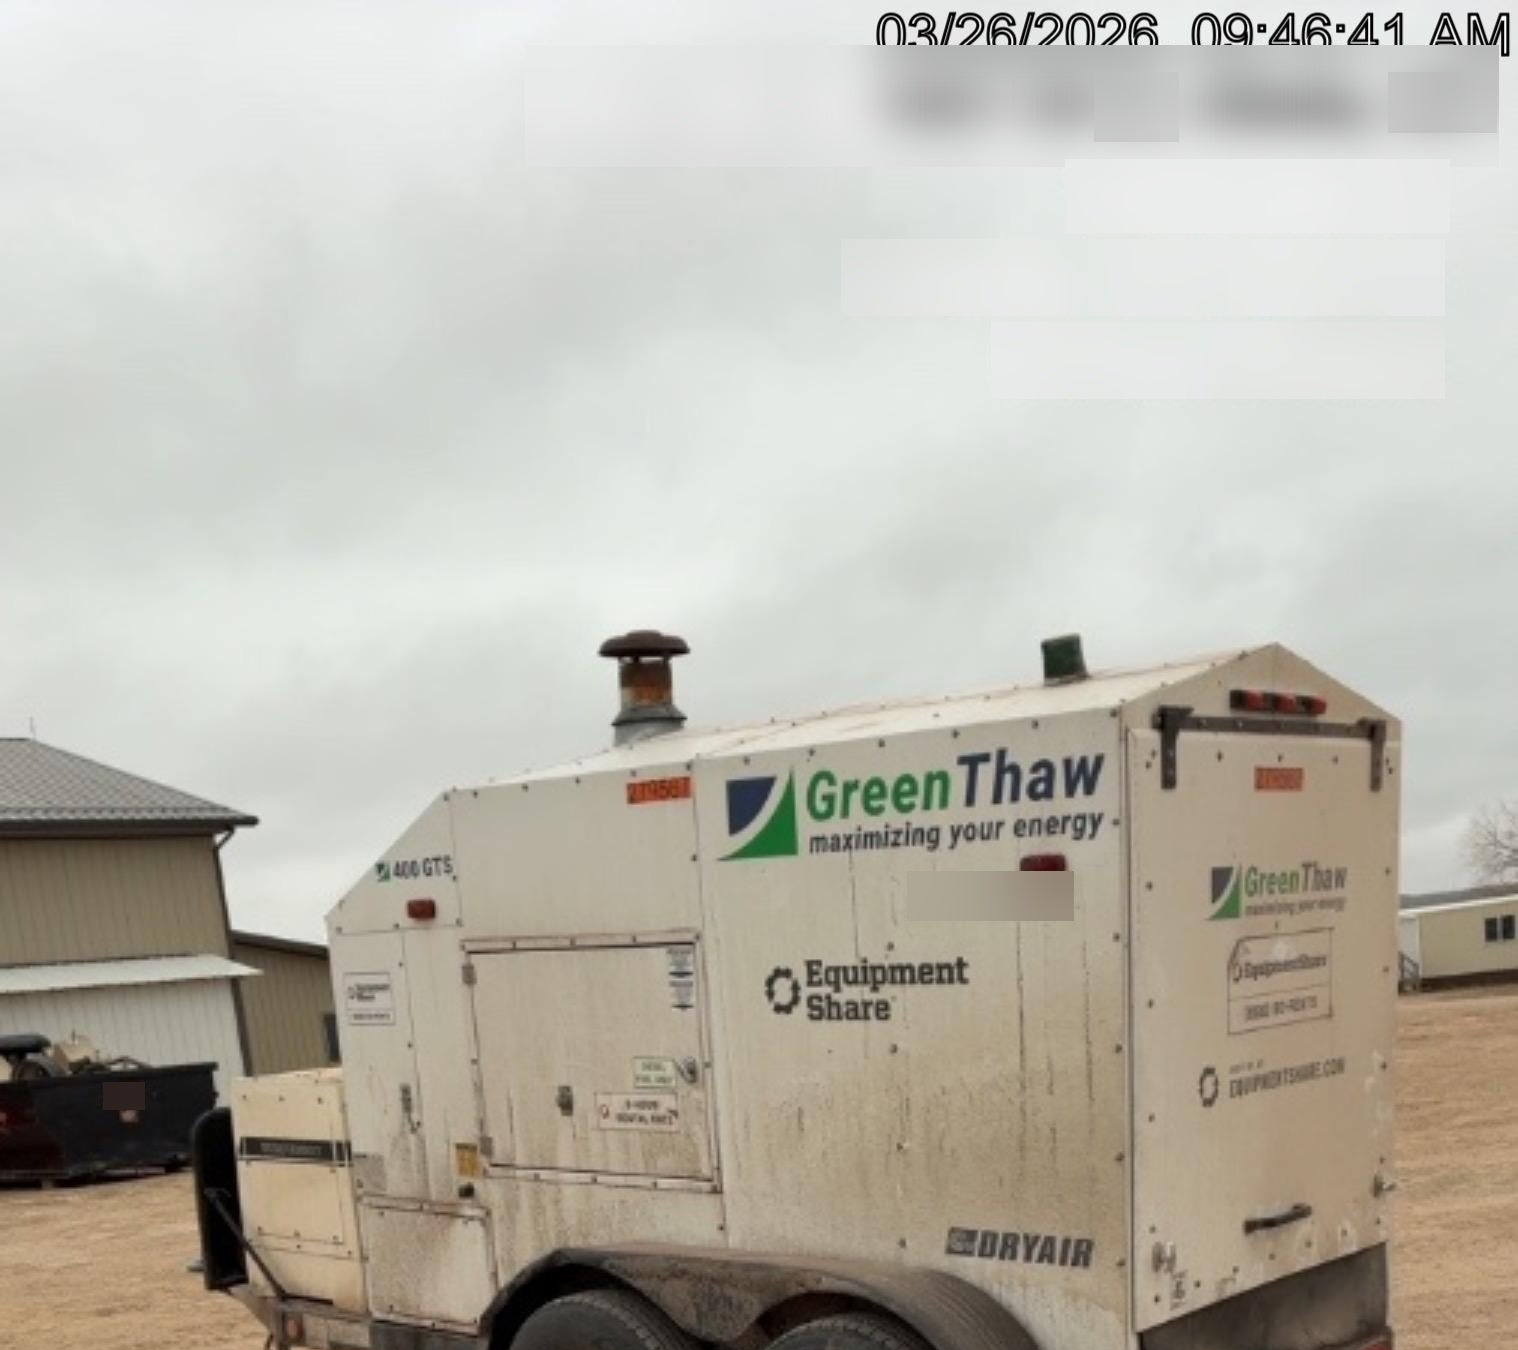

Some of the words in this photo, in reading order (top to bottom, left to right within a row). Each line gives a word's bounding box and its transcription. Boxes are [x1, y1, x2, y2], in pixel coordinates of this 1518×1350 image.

[809, 822, 941, 855] maximizing
[948, 819, 1005, 850] your
[1013, 811, 1104, 841] energy
[394, 859, 420, 879] 400
[422, 855, 454, 877] GTS
[804, 956, 970, 993] Equipment
[805, 994, 892, 1022] Share
[976, 1229, 1095, 1269] DRYAIR
